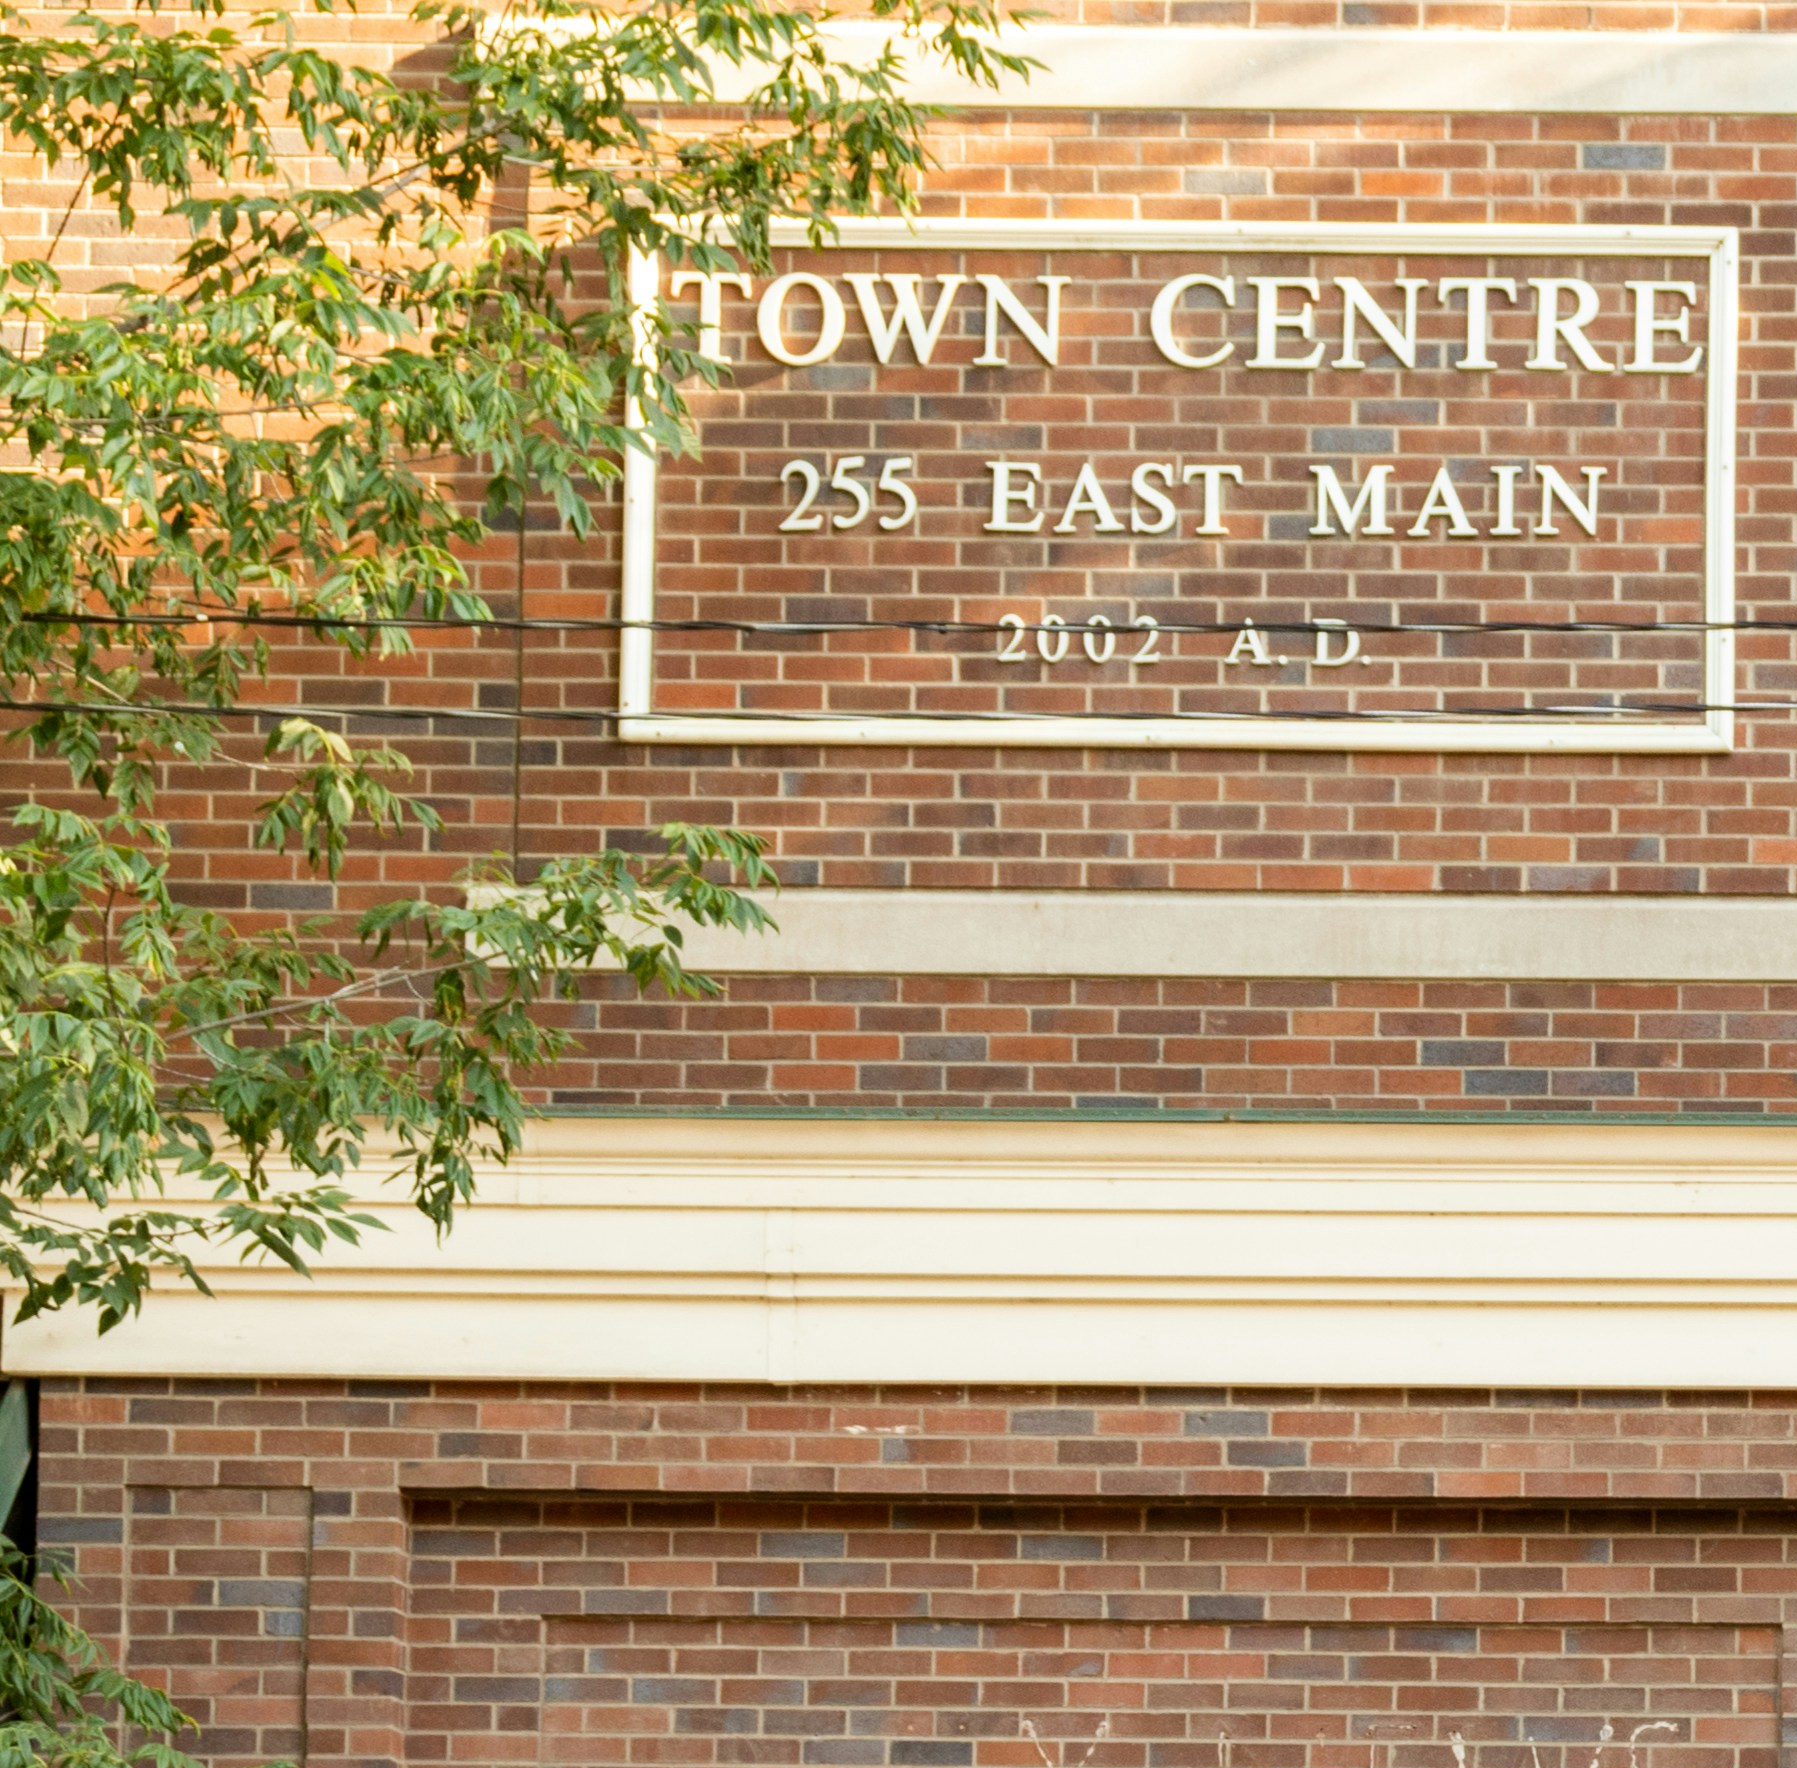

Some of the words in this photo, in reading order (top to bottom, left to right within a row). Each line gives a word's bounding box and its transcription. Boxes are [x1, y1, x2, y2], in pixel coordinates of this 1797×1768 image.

[670, 270, 1072, 369] TOWN
[1149, 273, 1704, 375] CENTRE
[778, 456, 920, 533] 255
[983, 460, 1245, 536] EAST
[1308, 463, 1609, 538] MAIN
[997, 613, 1163, 666] 2002
